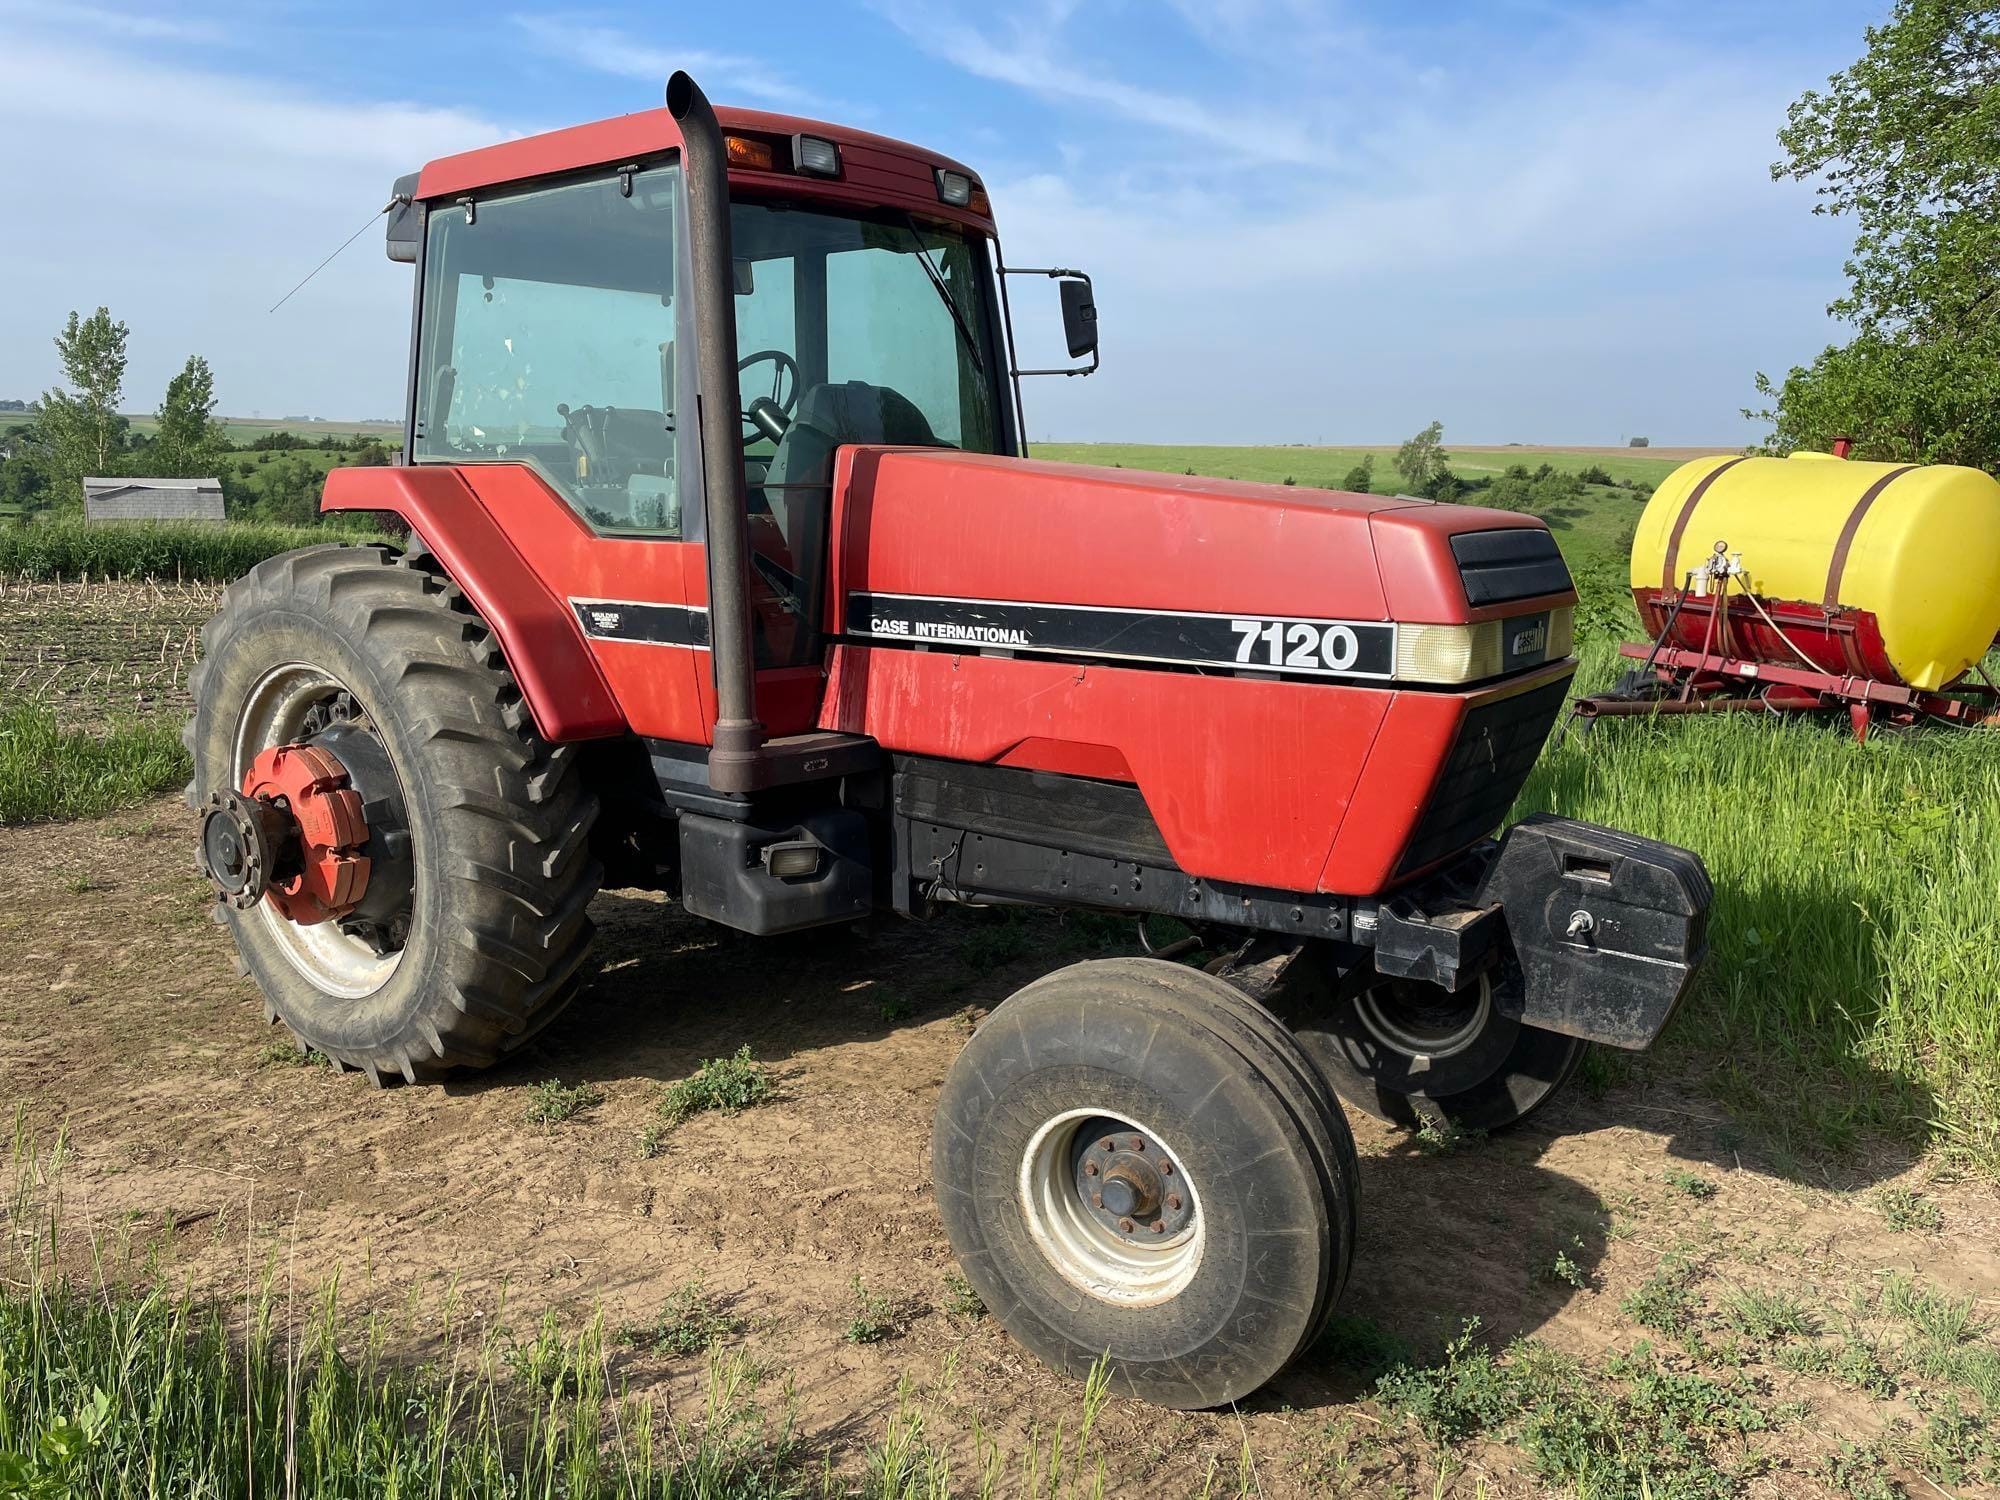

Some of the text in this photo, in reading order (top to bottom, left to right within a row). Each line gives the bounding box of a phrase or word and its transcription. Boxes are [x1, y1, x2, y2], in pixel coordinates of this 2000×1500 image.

[871, 618, 1030, 645] CASE INTERNATIONAL
[1231, 619, 1359, 671] 7120
